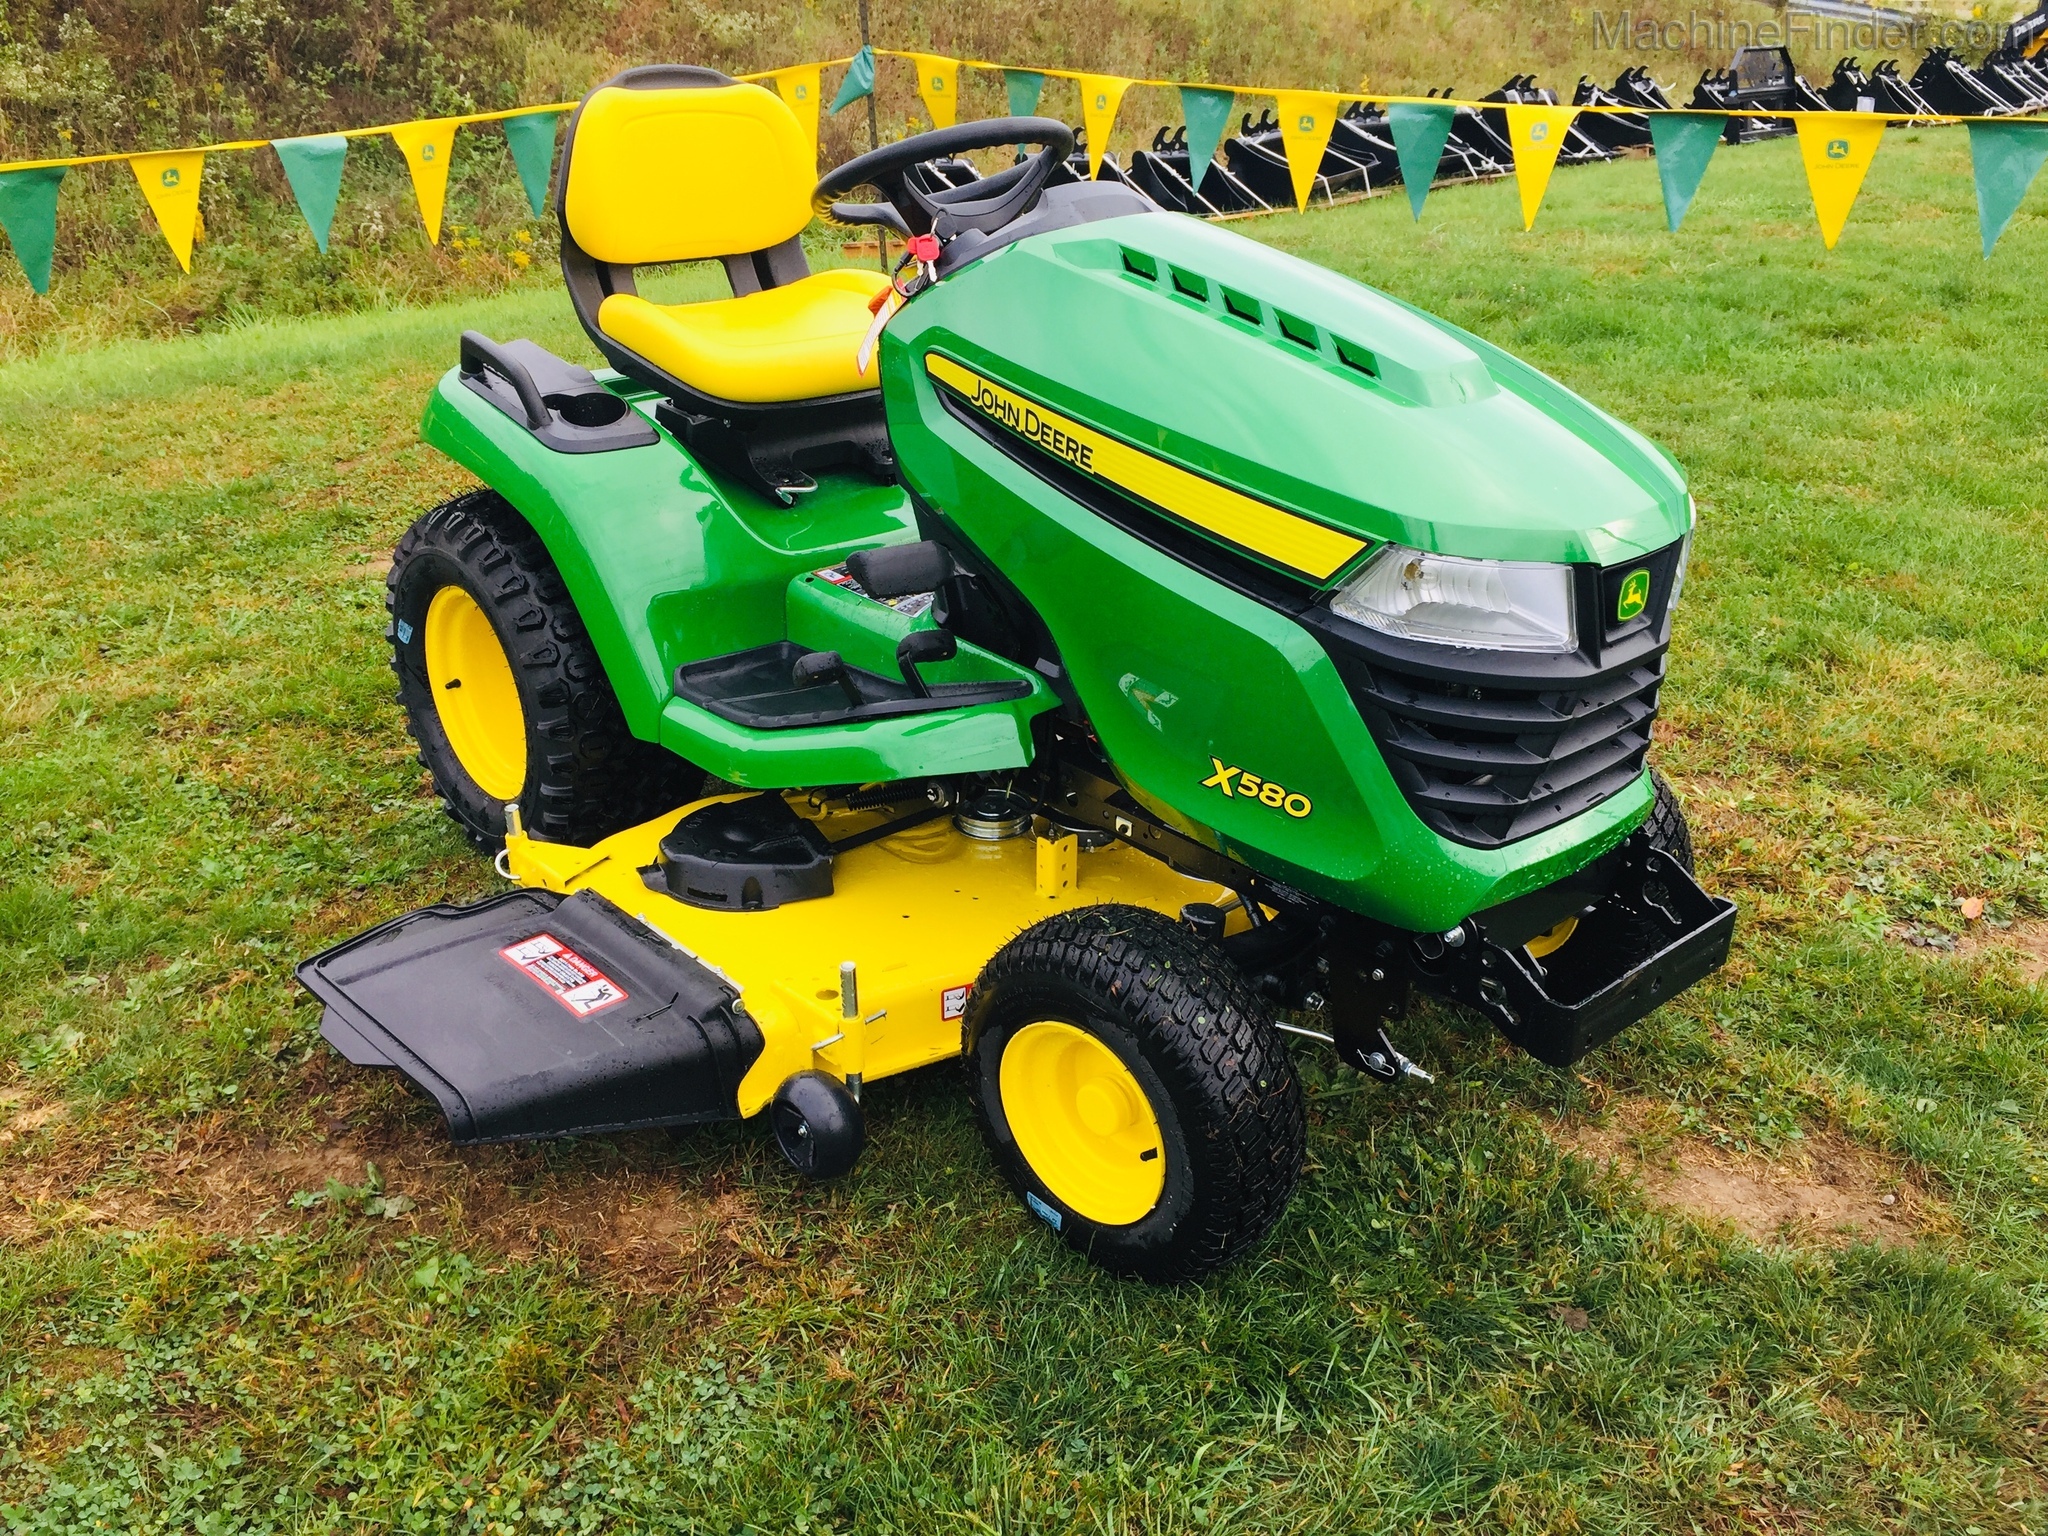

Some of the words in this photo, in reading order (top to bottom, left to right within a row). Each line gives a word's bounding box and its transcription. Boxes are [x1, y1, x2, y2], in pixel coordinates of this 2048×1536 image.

[970, 379, 1020, 428] JOHN
[1024, 407, 1094, 470] DEERE
[1198, 755, 1313, 819] X580
[570, 955, 599, 977] DANGER
